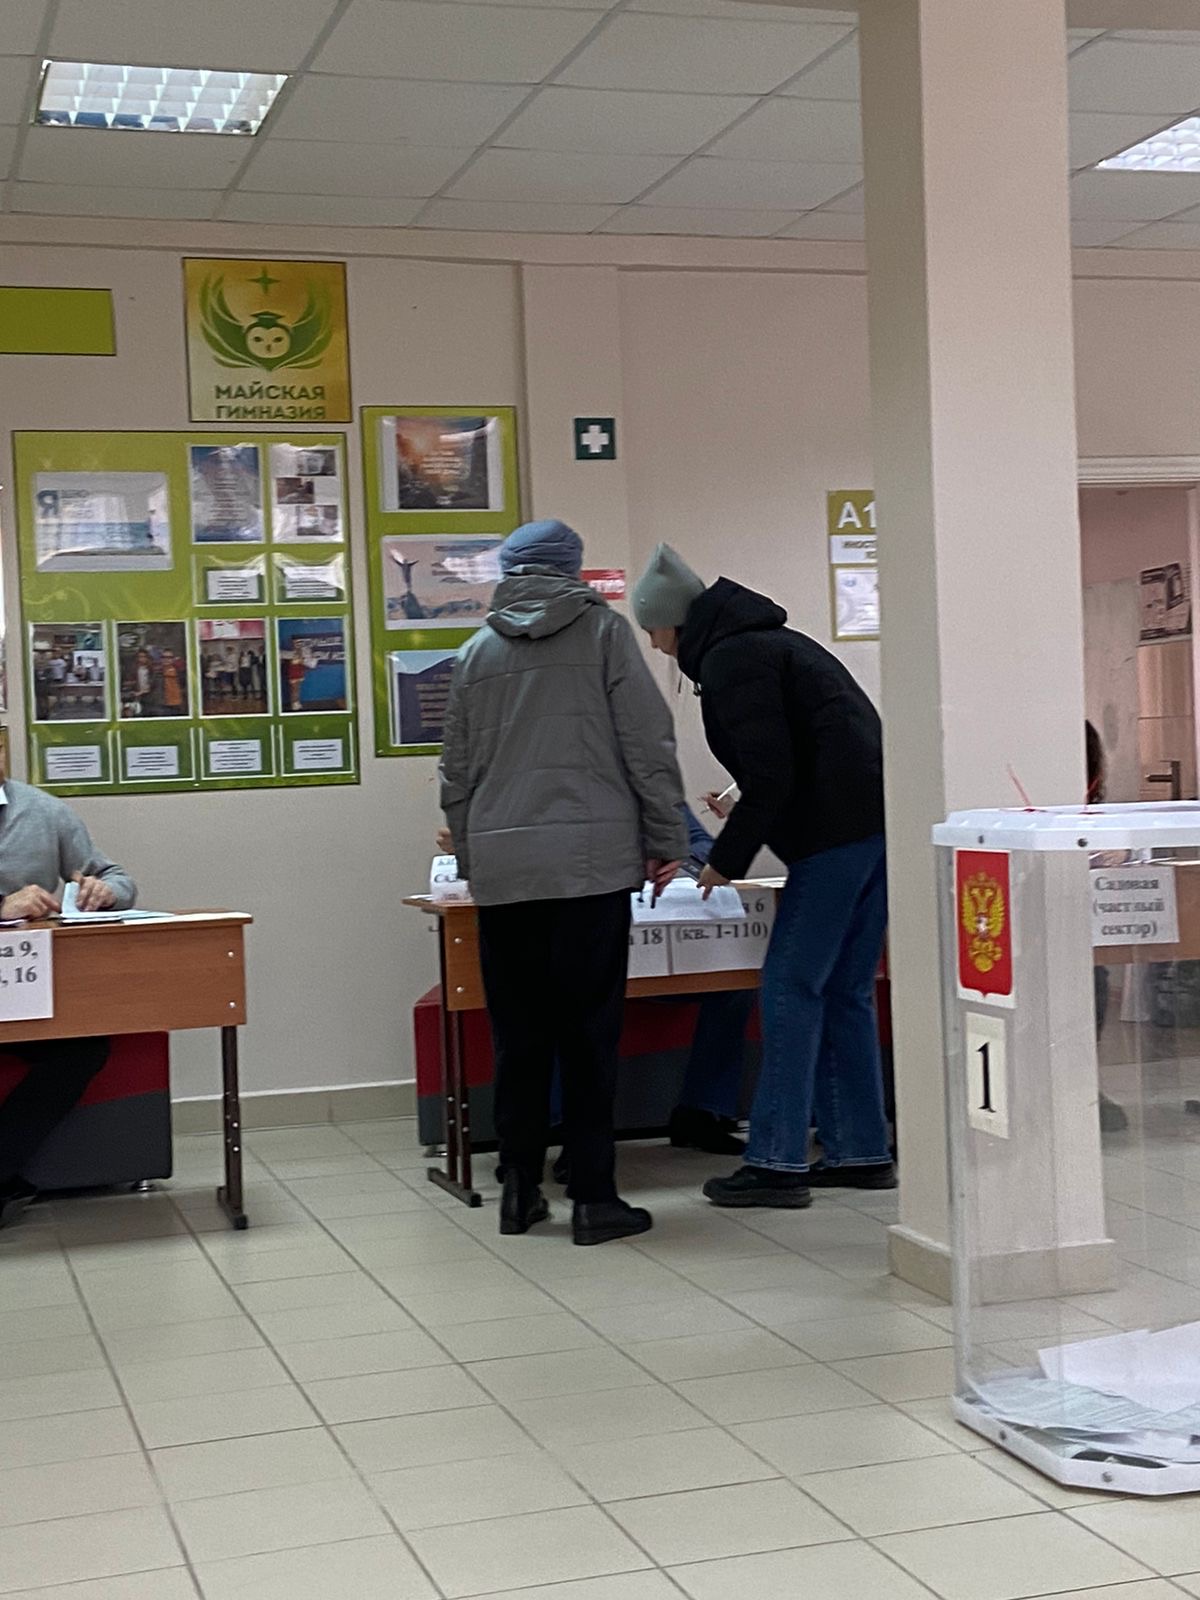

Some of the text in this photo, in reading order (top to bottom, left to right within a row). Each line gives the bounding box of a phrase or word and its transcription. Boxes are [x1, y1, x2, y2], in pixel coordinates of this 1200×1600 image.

[215, 381, 325, 400] МАЙСКАЯ
[215, 405, 326, 419] ГИМНАЗИЯ
[641, 927, 663, 945] 18
[716, 922, 768, 939] 1-110)
[19, 940, 38, 960] 9,
[14, 966, 37, 983] 16
[976, 1041, 997, 1113] 1
